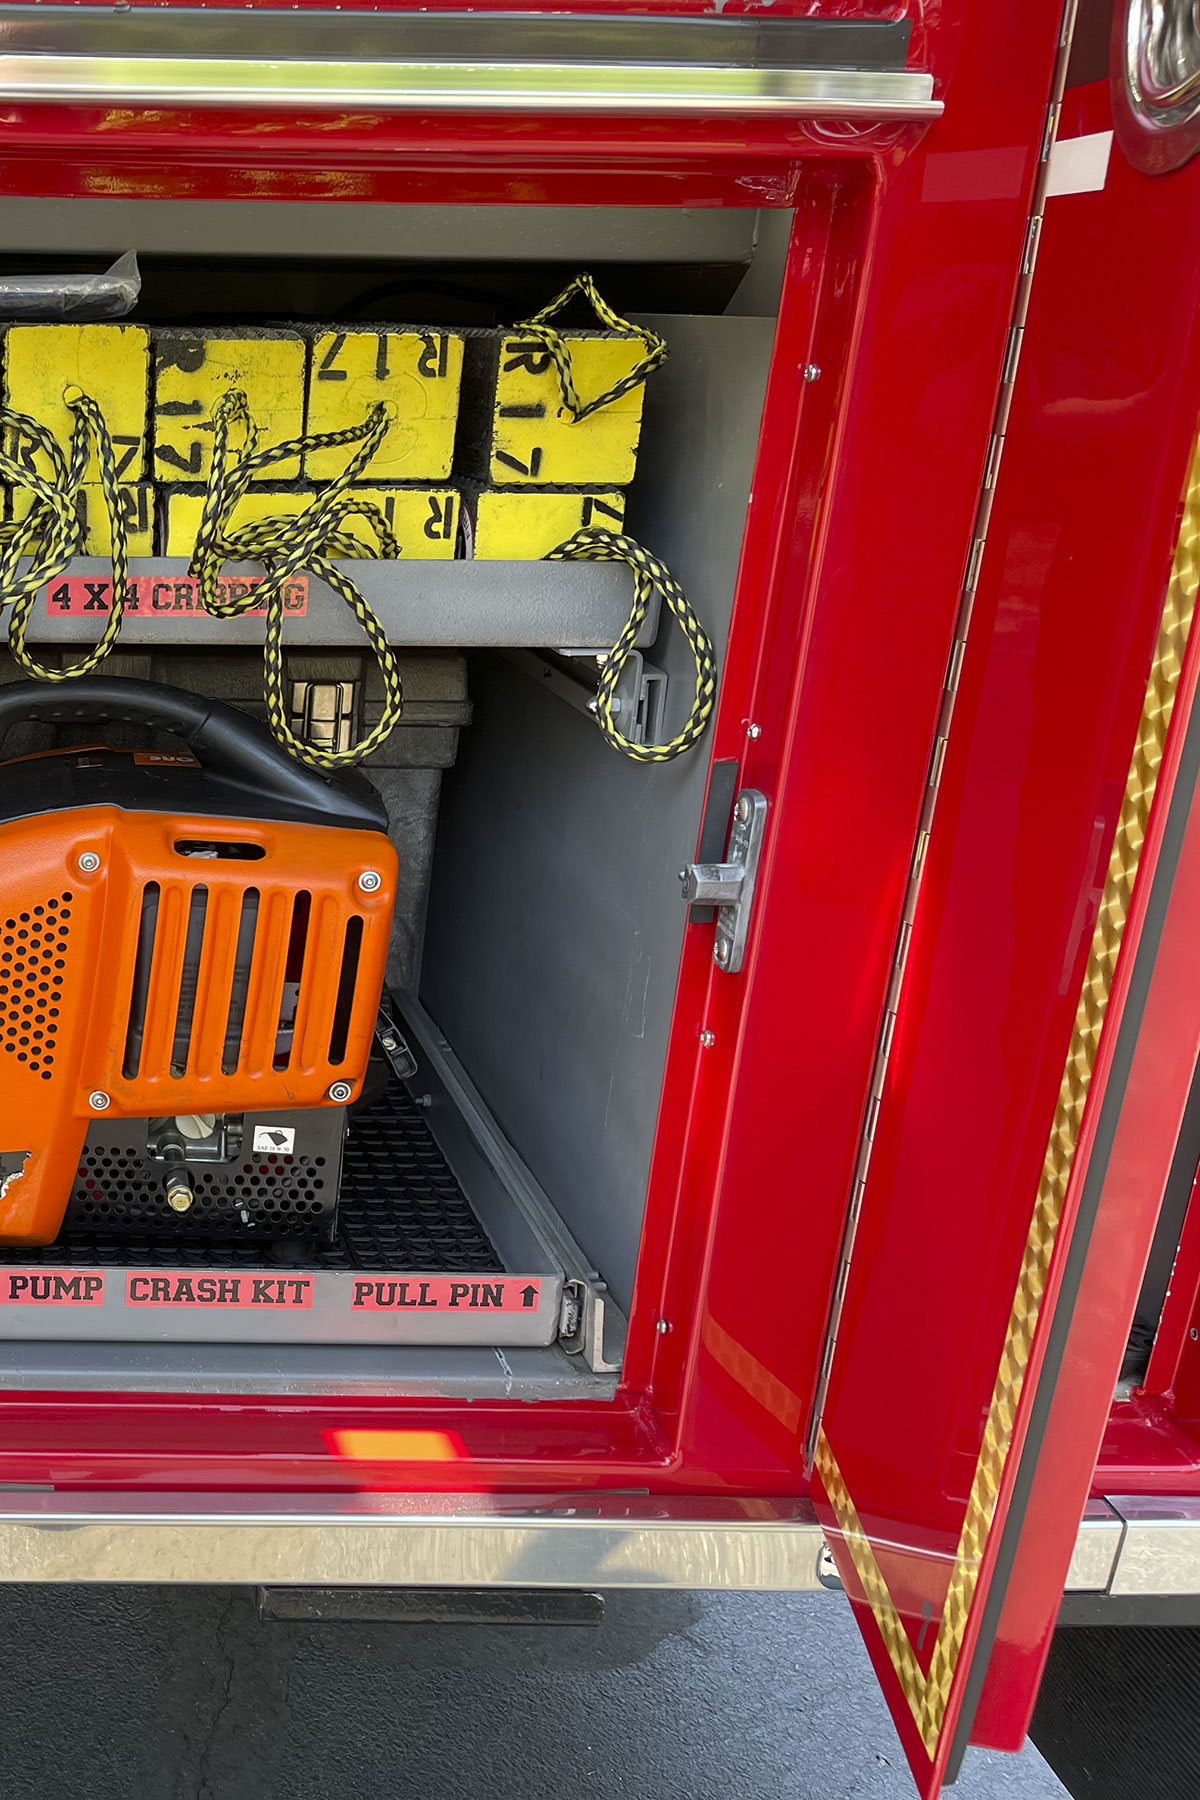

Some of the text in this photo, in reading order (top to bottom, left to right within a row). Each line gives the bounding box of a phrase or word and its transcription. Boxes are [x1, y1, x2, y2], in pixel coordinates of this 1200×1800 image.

[317, 333, 449, 381] R17
[496, 341, 553, 477] R17
[8, 426, 141, 478] R7
[52, 583, 71, 610] 4
[83, 583, 110, 610] X
[122, 583, 140, 610] 4
[8, 1276, 103, 1300] PUMP
[130, 1278, 310, 1304] CRASH KIT
[353, 1283, 504, 1307] PULL PIN
